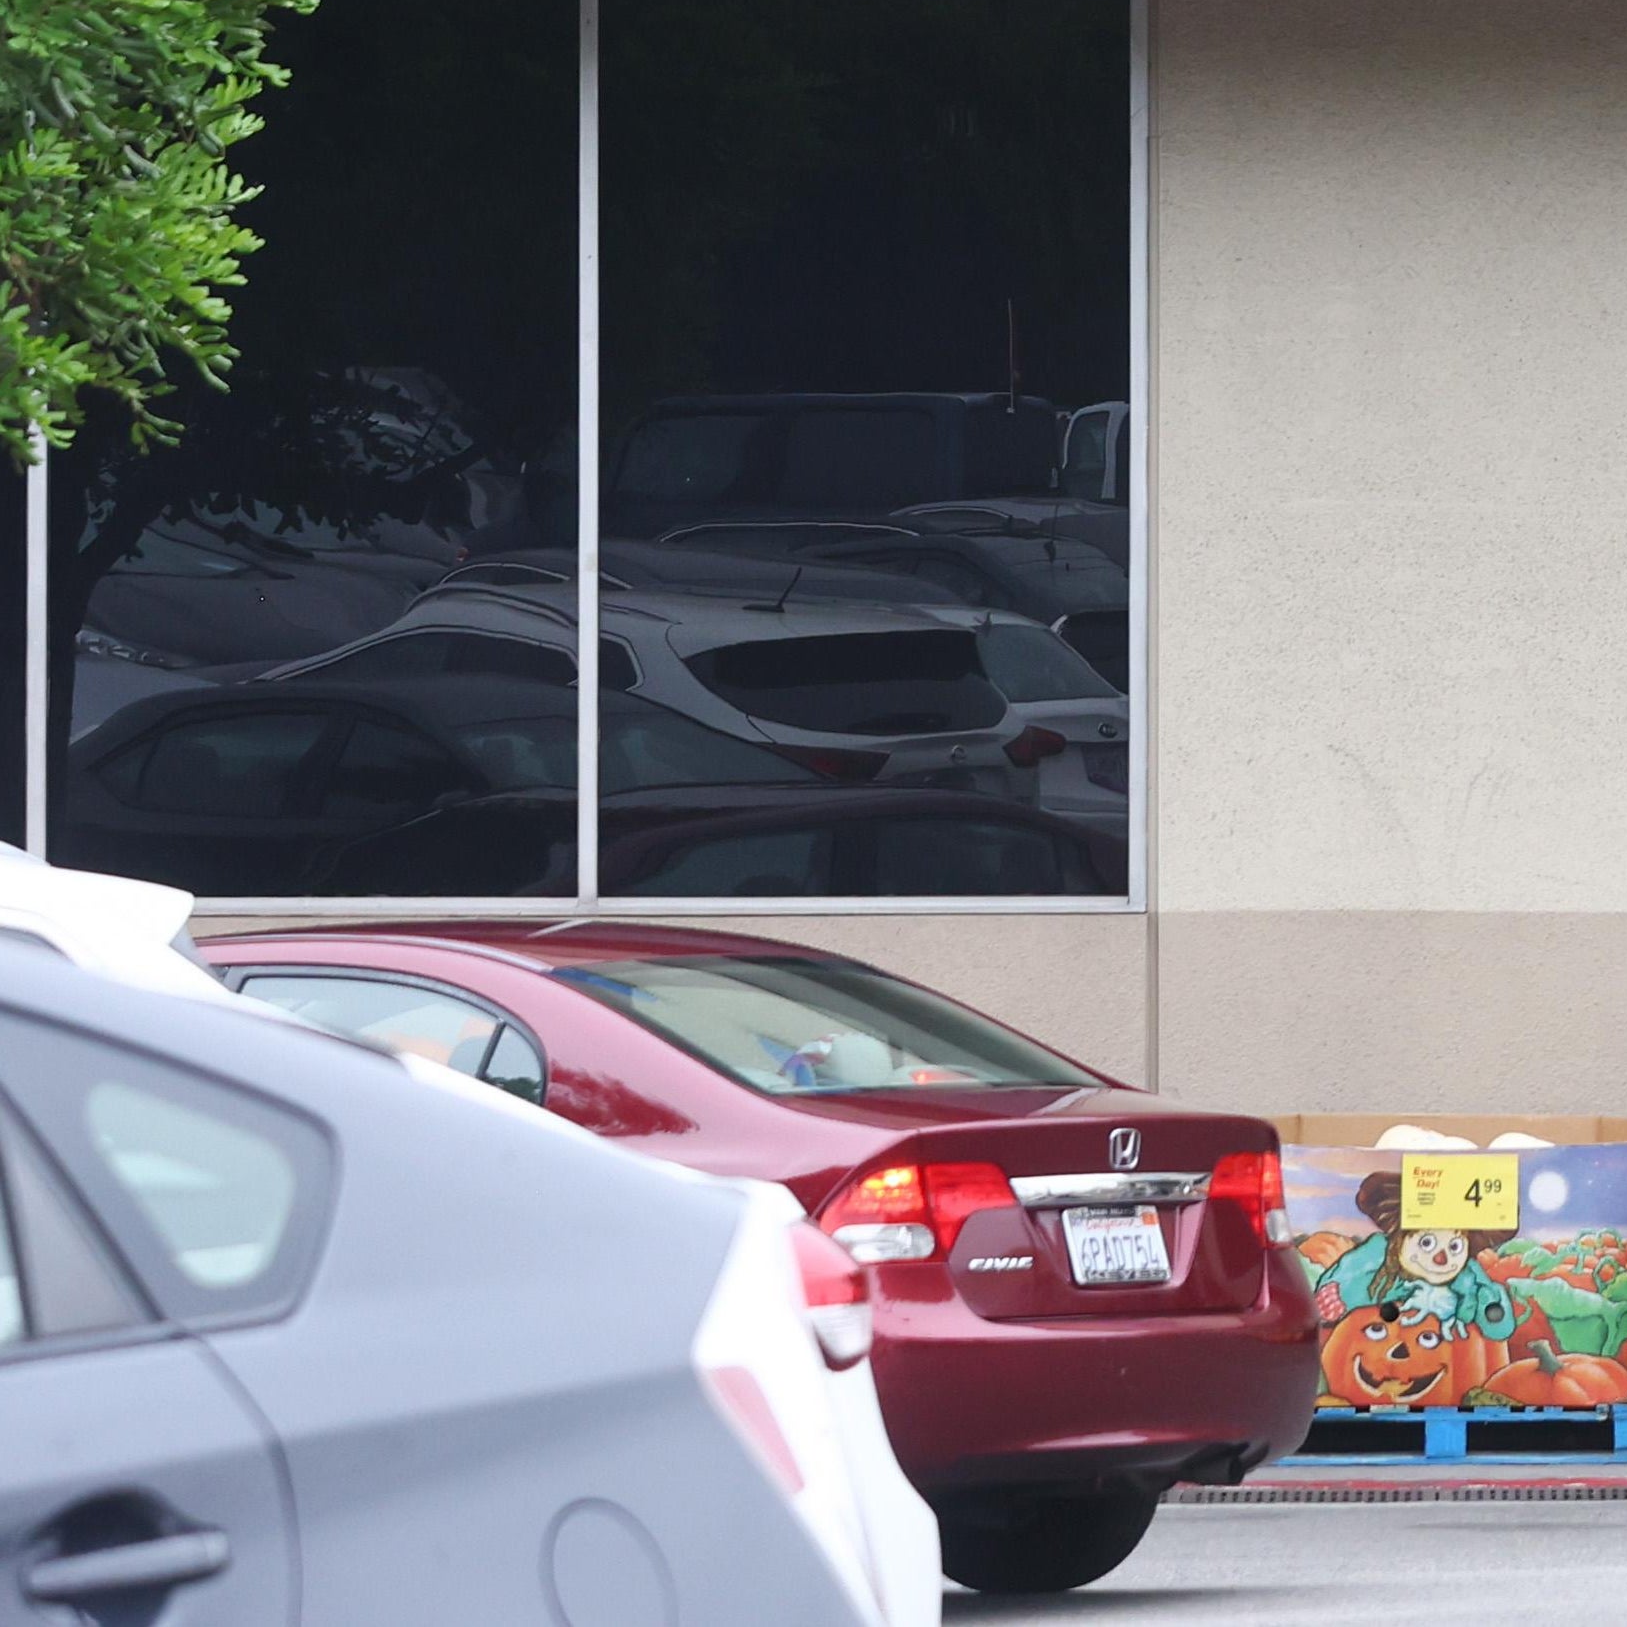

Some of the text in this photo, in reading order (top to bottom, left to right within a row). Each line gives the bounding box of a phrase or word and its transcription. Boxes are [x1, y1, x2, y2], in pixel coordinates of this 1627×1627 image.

[1413, 1166, 1444, 1179] Every
[1416, 1179, 1441, 1190] Day!
[1082, 1235, 1160, 1271] 6PAD754
[968, 1255, 1034, 1271] CIVIC
